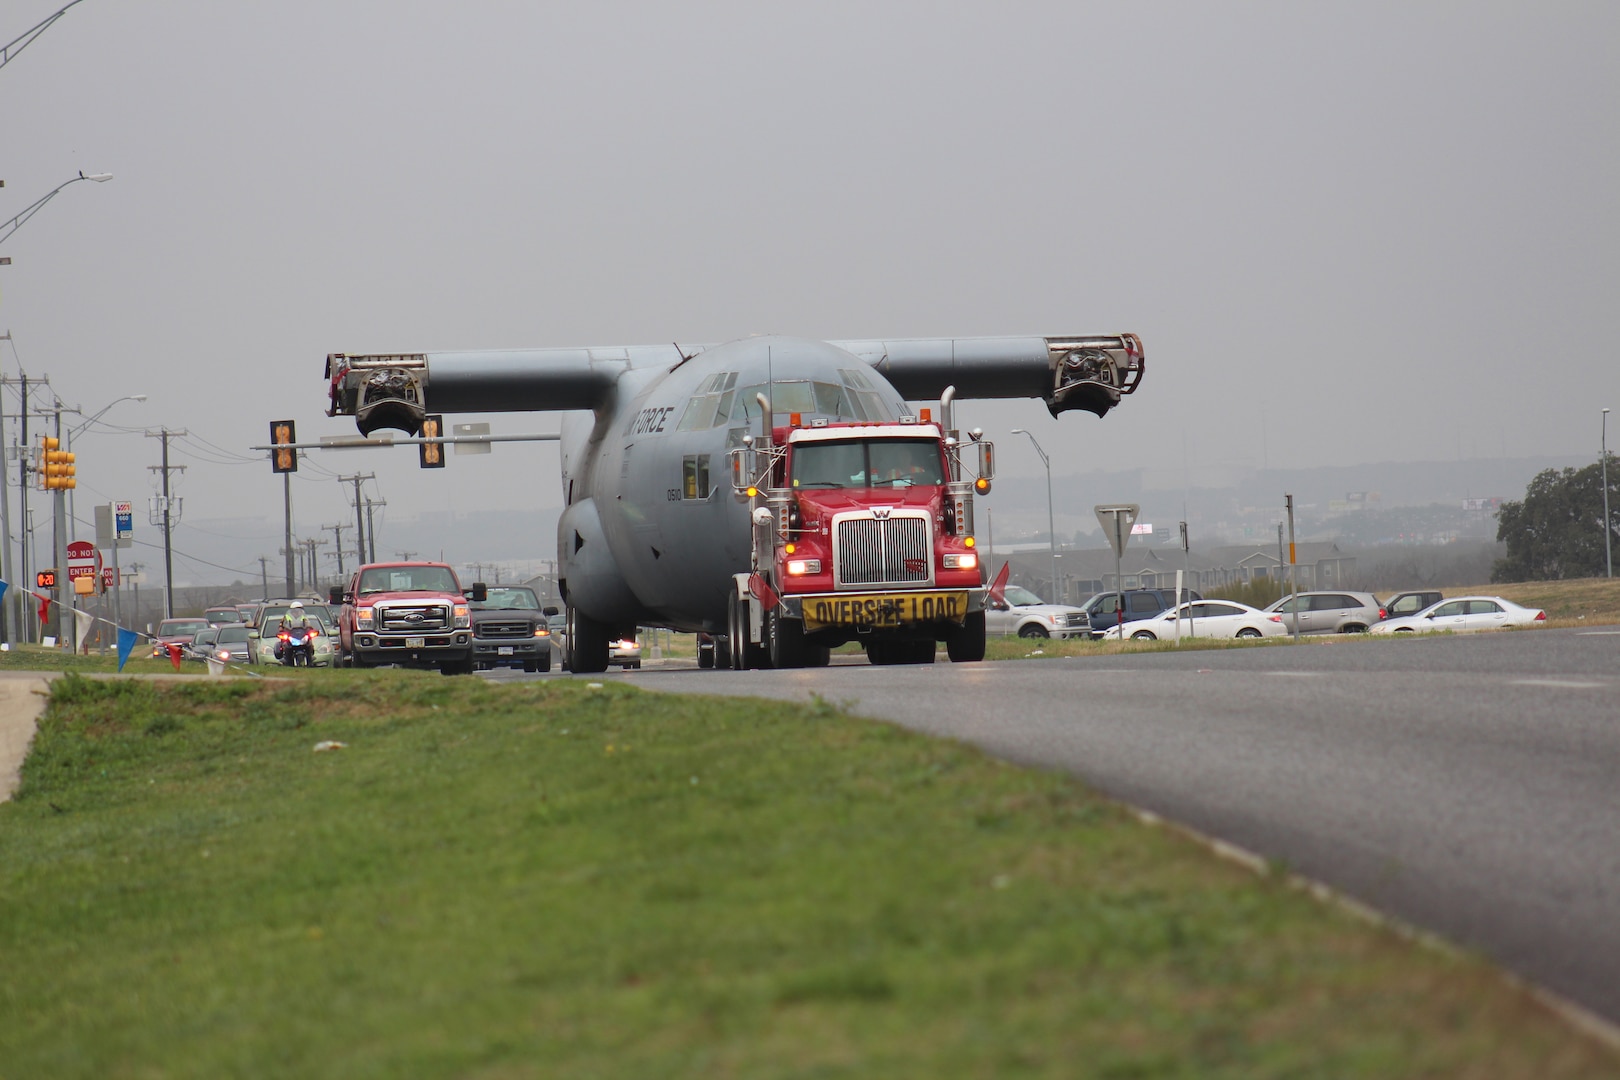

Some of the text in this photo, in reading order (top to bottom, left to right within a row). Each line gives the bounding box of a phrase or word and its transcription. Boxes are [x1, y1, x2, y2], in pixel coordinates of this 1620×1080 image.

[67, 550, 77, 558] DO
[816, 596, 957, 625] OVERSIZE LOAD
